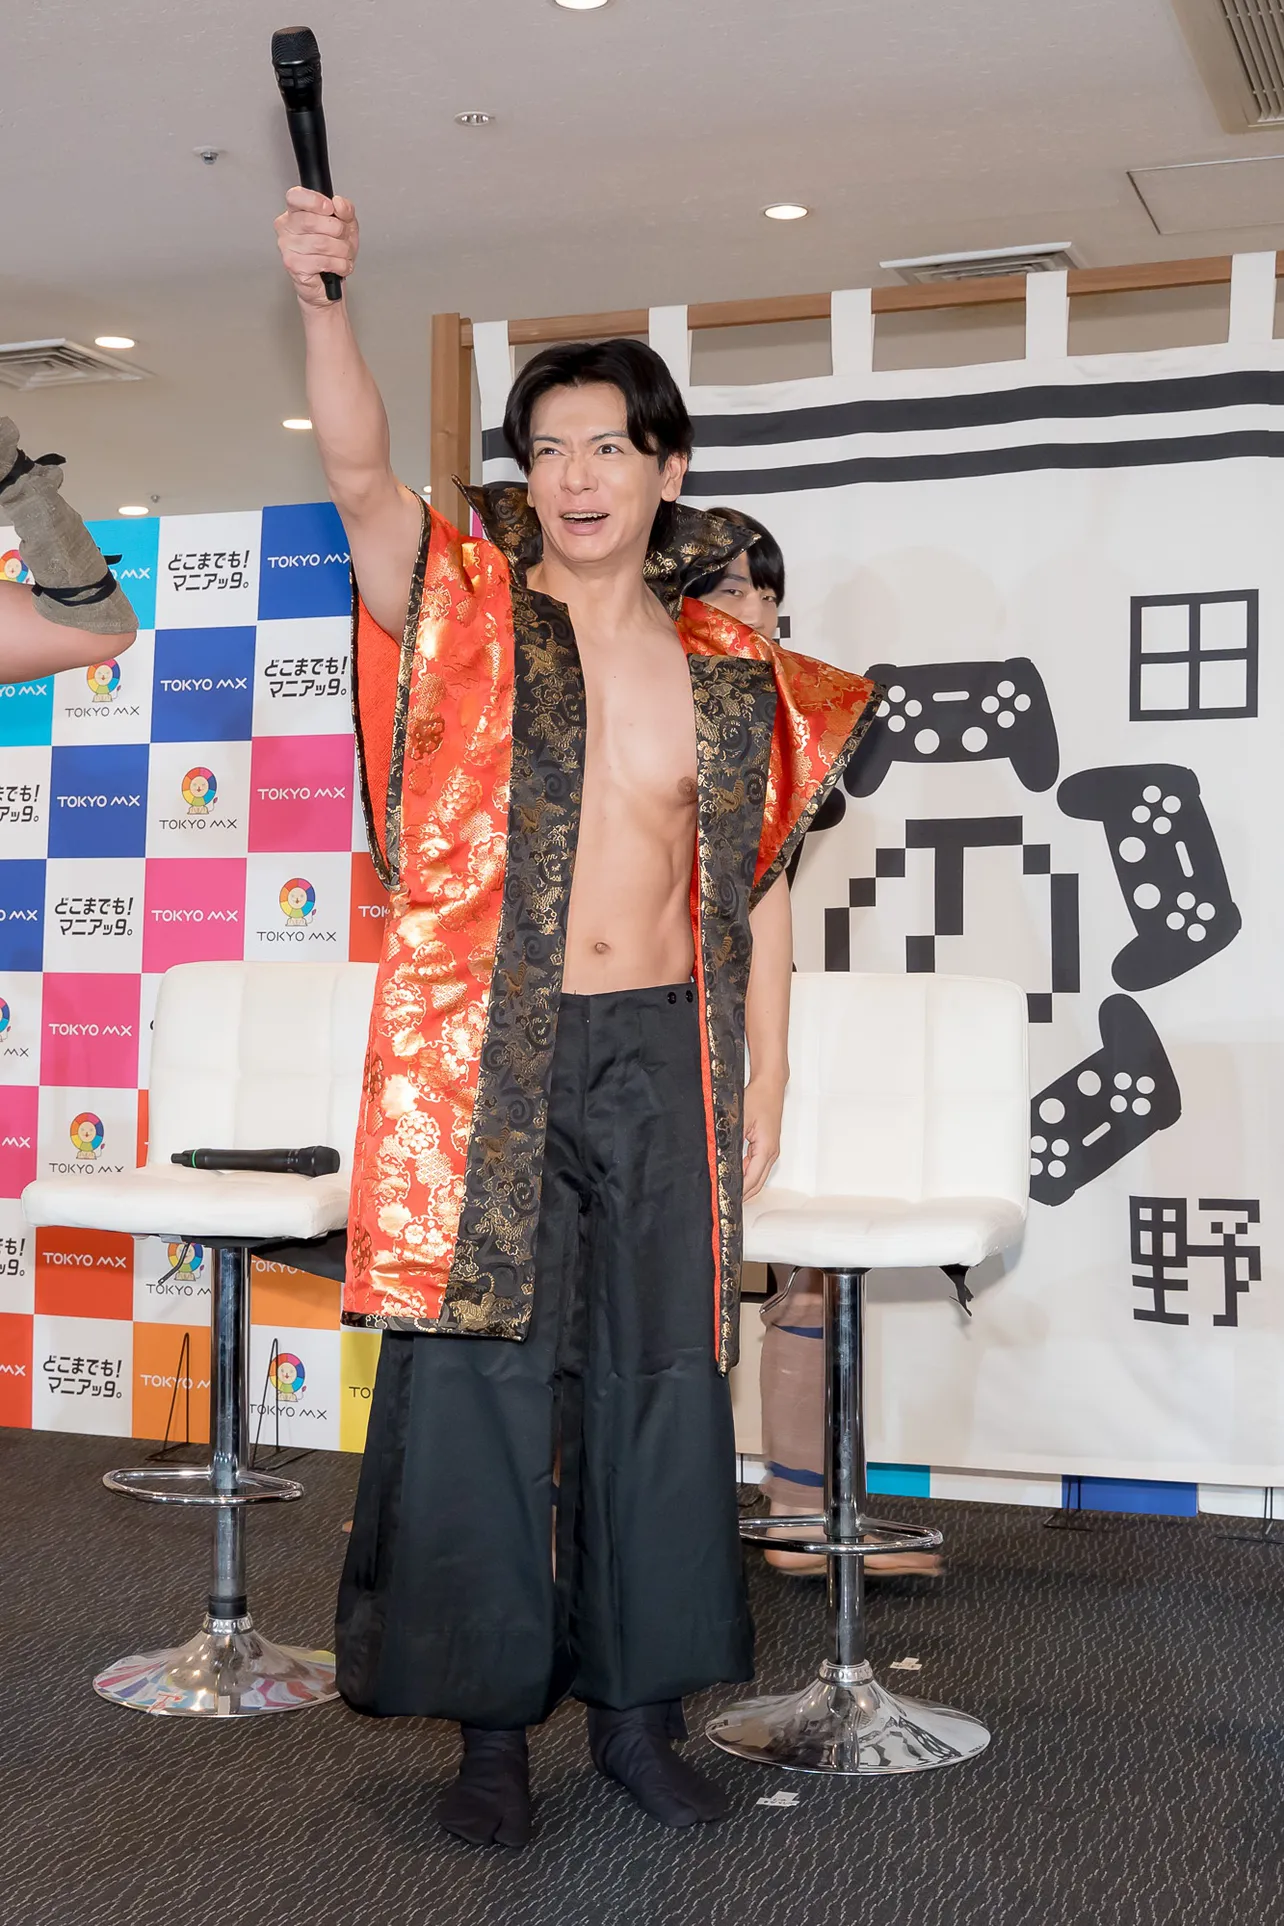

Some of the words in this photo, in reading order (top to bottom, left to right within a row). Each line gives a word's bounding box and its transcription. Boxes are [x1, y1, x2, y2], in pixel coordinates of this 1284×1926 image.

[168, 550, 250, 571] どこまでも!
[267, 553, 320, 568] TOKYO
[120, 567, 151, 580] MX
[1130, 589, 1258, 721] 田
[264, 656, 348, 677] どこまでも!
[18, 684, 47, 696] MX
[160, 679, 213, 692] TOKYO
[216, 678, 247, 690] MX
[65, 707, 110, 718] TOKYO
[113, 706, 140, 716] MX
[0, 784, 40, 802] でも!
[257, 787, 311, 800] TOKYO
[314, 787, 346, 799] MX
[57, 795, 107, 808] TOKYO
[110, 795, 141, 807] MX
[0, 805, 39, 822] アッ9。
[159, 819, 206, 830] TOKYO
[210, 819, 237, 829] MX
[55, 897, 134, 916] どこまでも!
[9, 909, 38, 921] MX
[151, 909, 204, 922] TOKYO
[208, 909, 239, 922] MX
[256, 931, 305, 942] TOKYO
[308, 931, 337, 942] MX
[49, 1023, 99, 1036] TOKYO
[102, 1025, 132, 1037] MX
[4, 1048, 29, 1057] MX
[2, 1136, 31, 1148] MX
[49, 1163, 94, 1174] TOKYO
[43, 1252, 93, 1267] TOKYO
[97, 1256, 127, 1268] MX
[1130, 1195, 1262, 1327] 野
[251, 1260, 298, 1275] OKYO
[146, 1283, 193, 1296] TOKYO
[197, 1287, 212, 1296] M
[0, 1364, 26, 1377] MX
[43, 1355, 122, 1378] どこまでも!
[140, 1374, 193, 1389] TOKYO
[197, 1380, 210, 1389] M
[250, 1404, 295, 1417] TOKYO
[299, 1409, 327, 1420] MX
